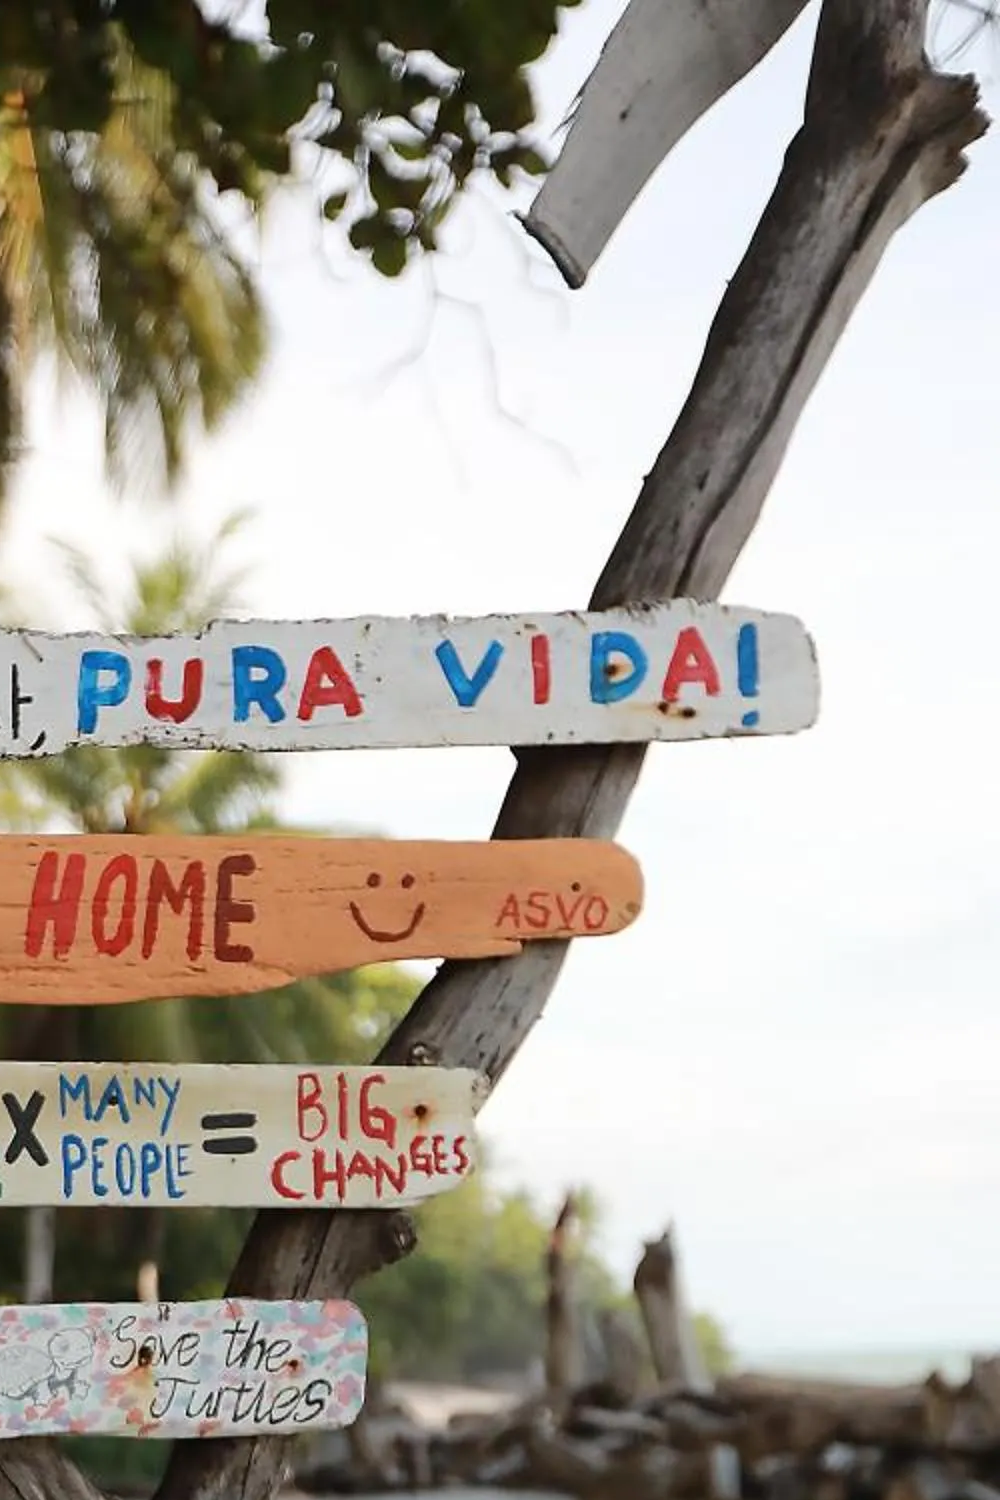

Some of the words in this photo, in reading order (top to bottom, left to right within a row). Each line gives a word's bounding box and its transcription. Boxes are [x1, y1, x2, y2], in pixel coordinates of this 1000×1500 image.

[77, 645, 363, 735] PURA
[434, 622, 761, 728] VIDA!
[23, 851, 256, 965] HOME
[494, 890, 609, 932] ASVO
[59, 1072, 182, 1137] MANY
[296, 1072, 398, 1150] BIG
[61, 1133, 196, 1200] PEOPLE
[270, 1134, 470, 1202] CHANGES
[223, 1318, 296, 1374] the
[149, 1376, 334, 1426] Turtles
